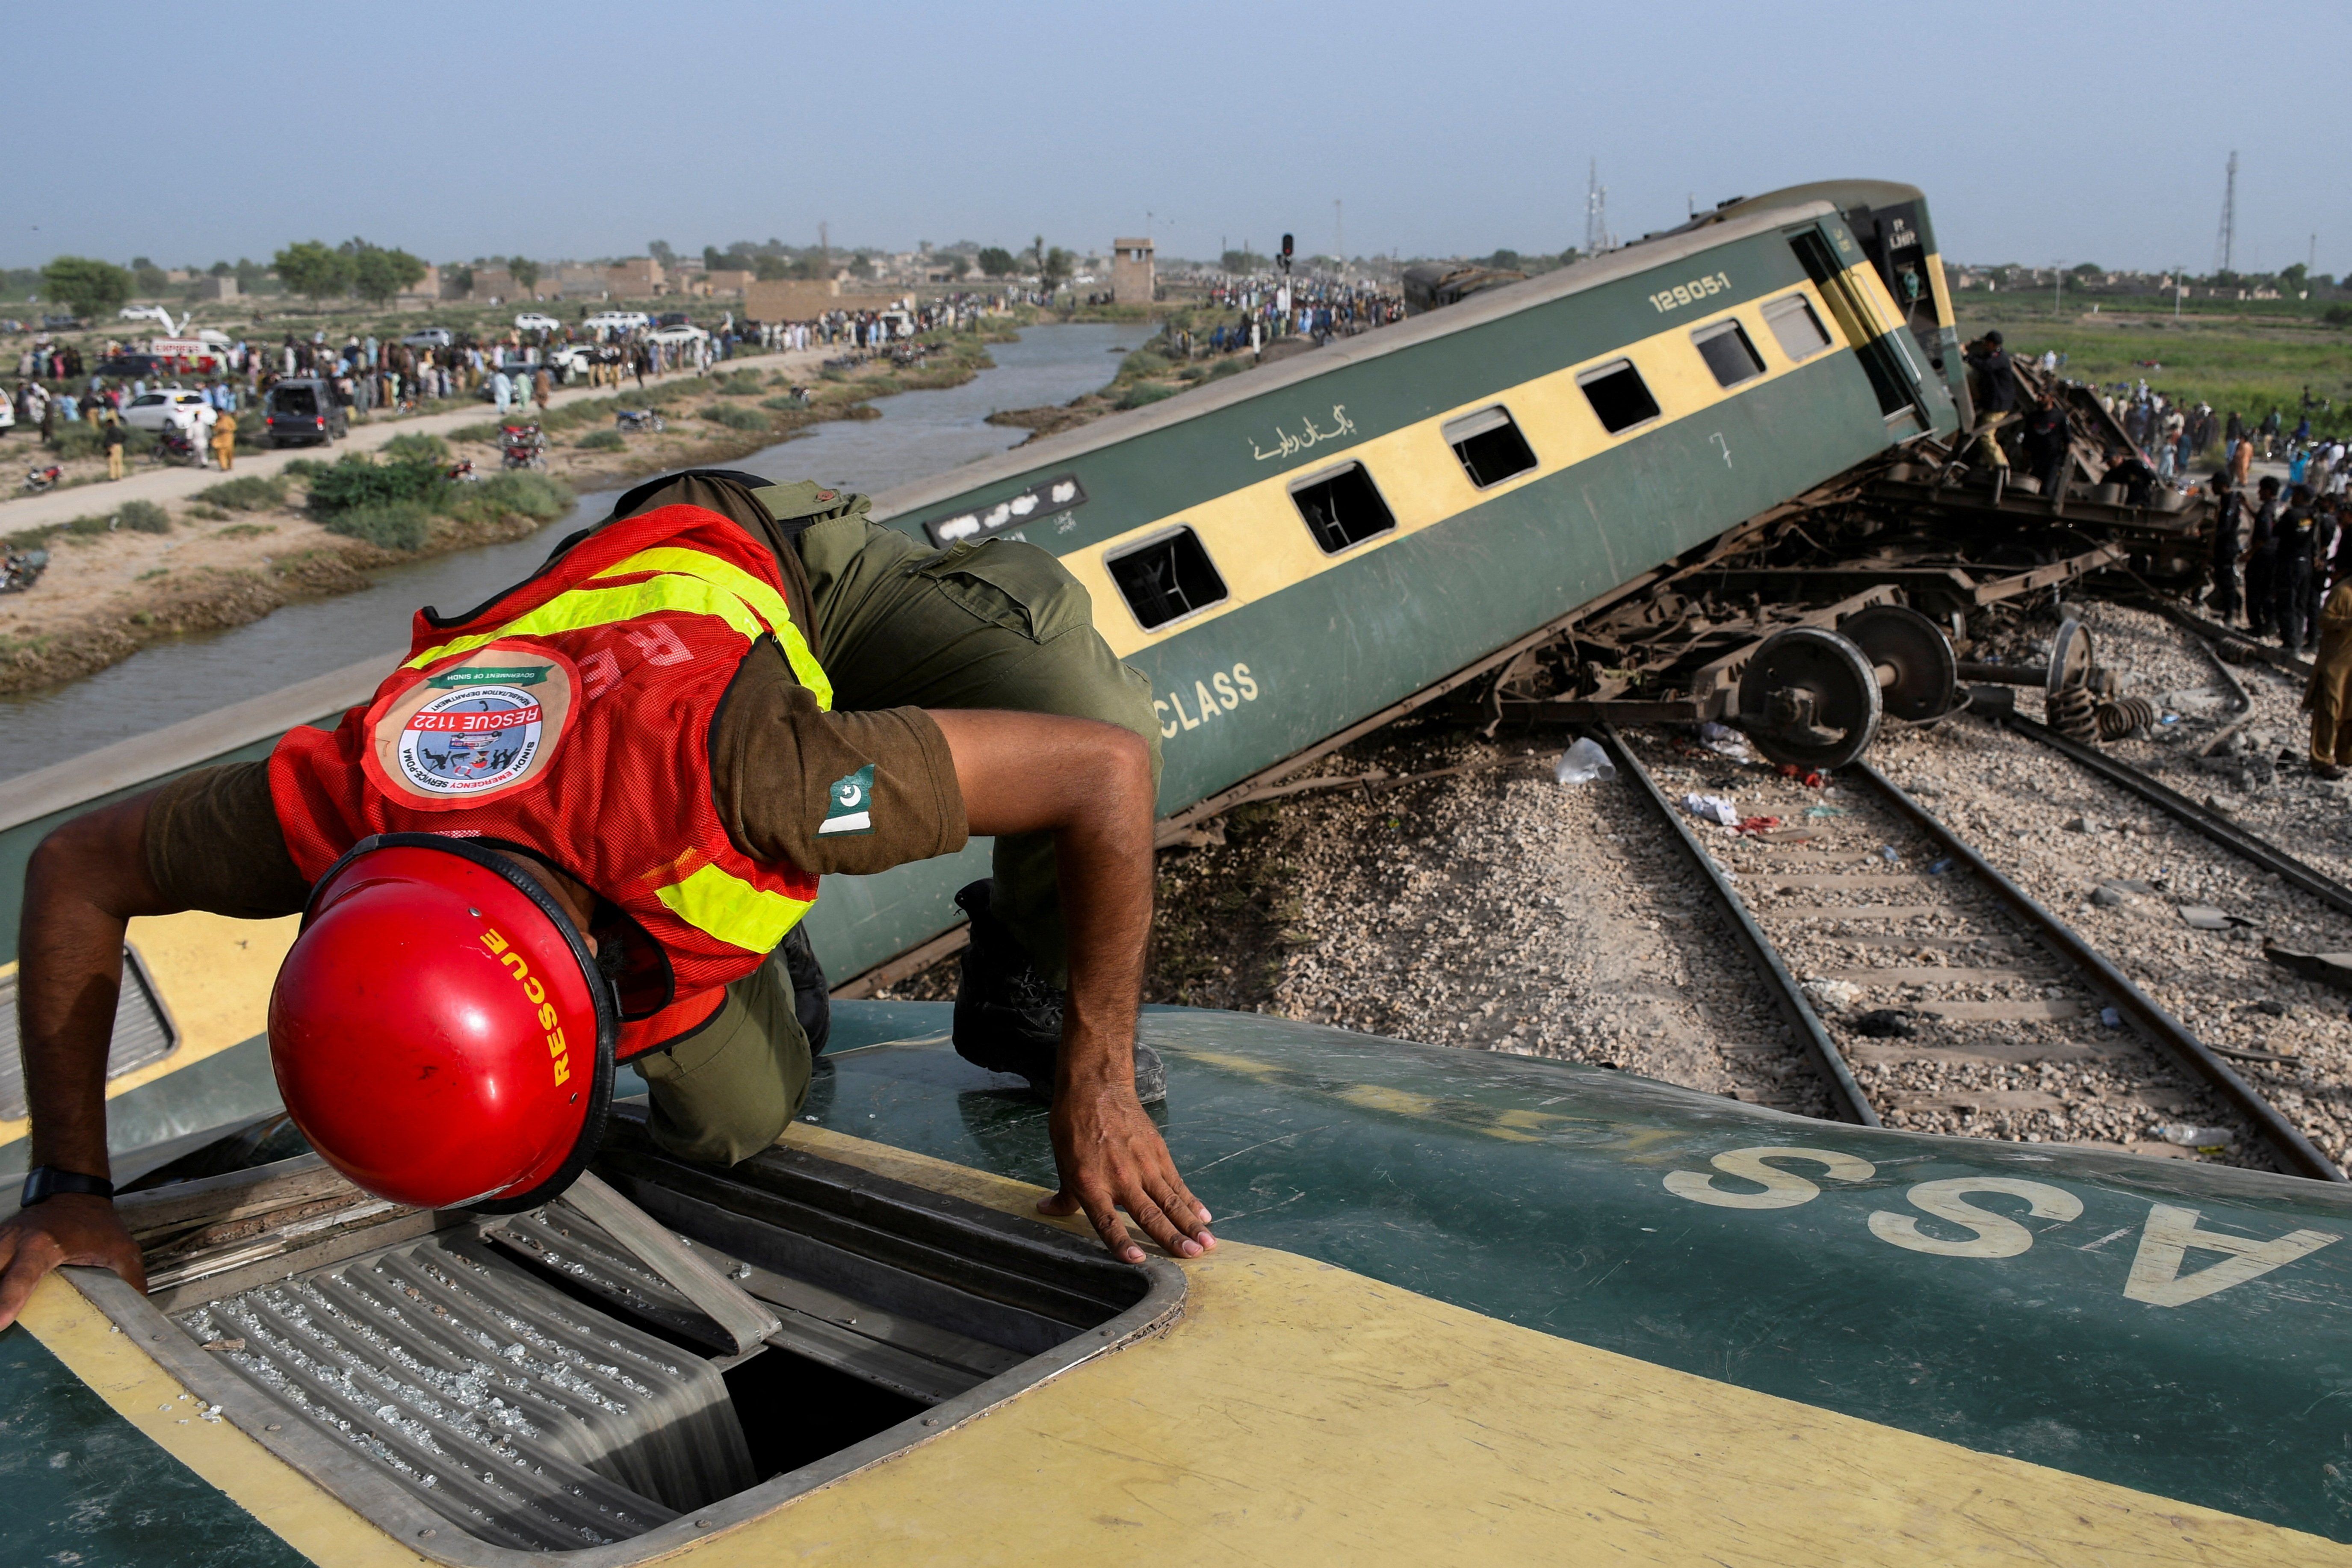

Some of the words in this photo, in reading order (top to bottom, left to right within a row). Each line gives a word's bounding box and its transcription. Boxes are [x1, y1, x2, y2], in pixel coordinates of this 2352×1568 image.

[1299, 405, 1358, 448] پاکستان
[431, 691, 481, 712] DEPARTMENT
[482, 690, 531, 706] REHABILITATION
[1153, 663, 1259, 739] CLASS
[414, 715, 455, 728] 1122
[463, 708, 539, 729] RESCUE
[403, 748, 449, 788] SERVICE-PDMA
[513, 741, 535, 772] SINDH
[449, 771, 513, 788] EMERGENCY
[479, 928, 570, 1087] RESCUE
